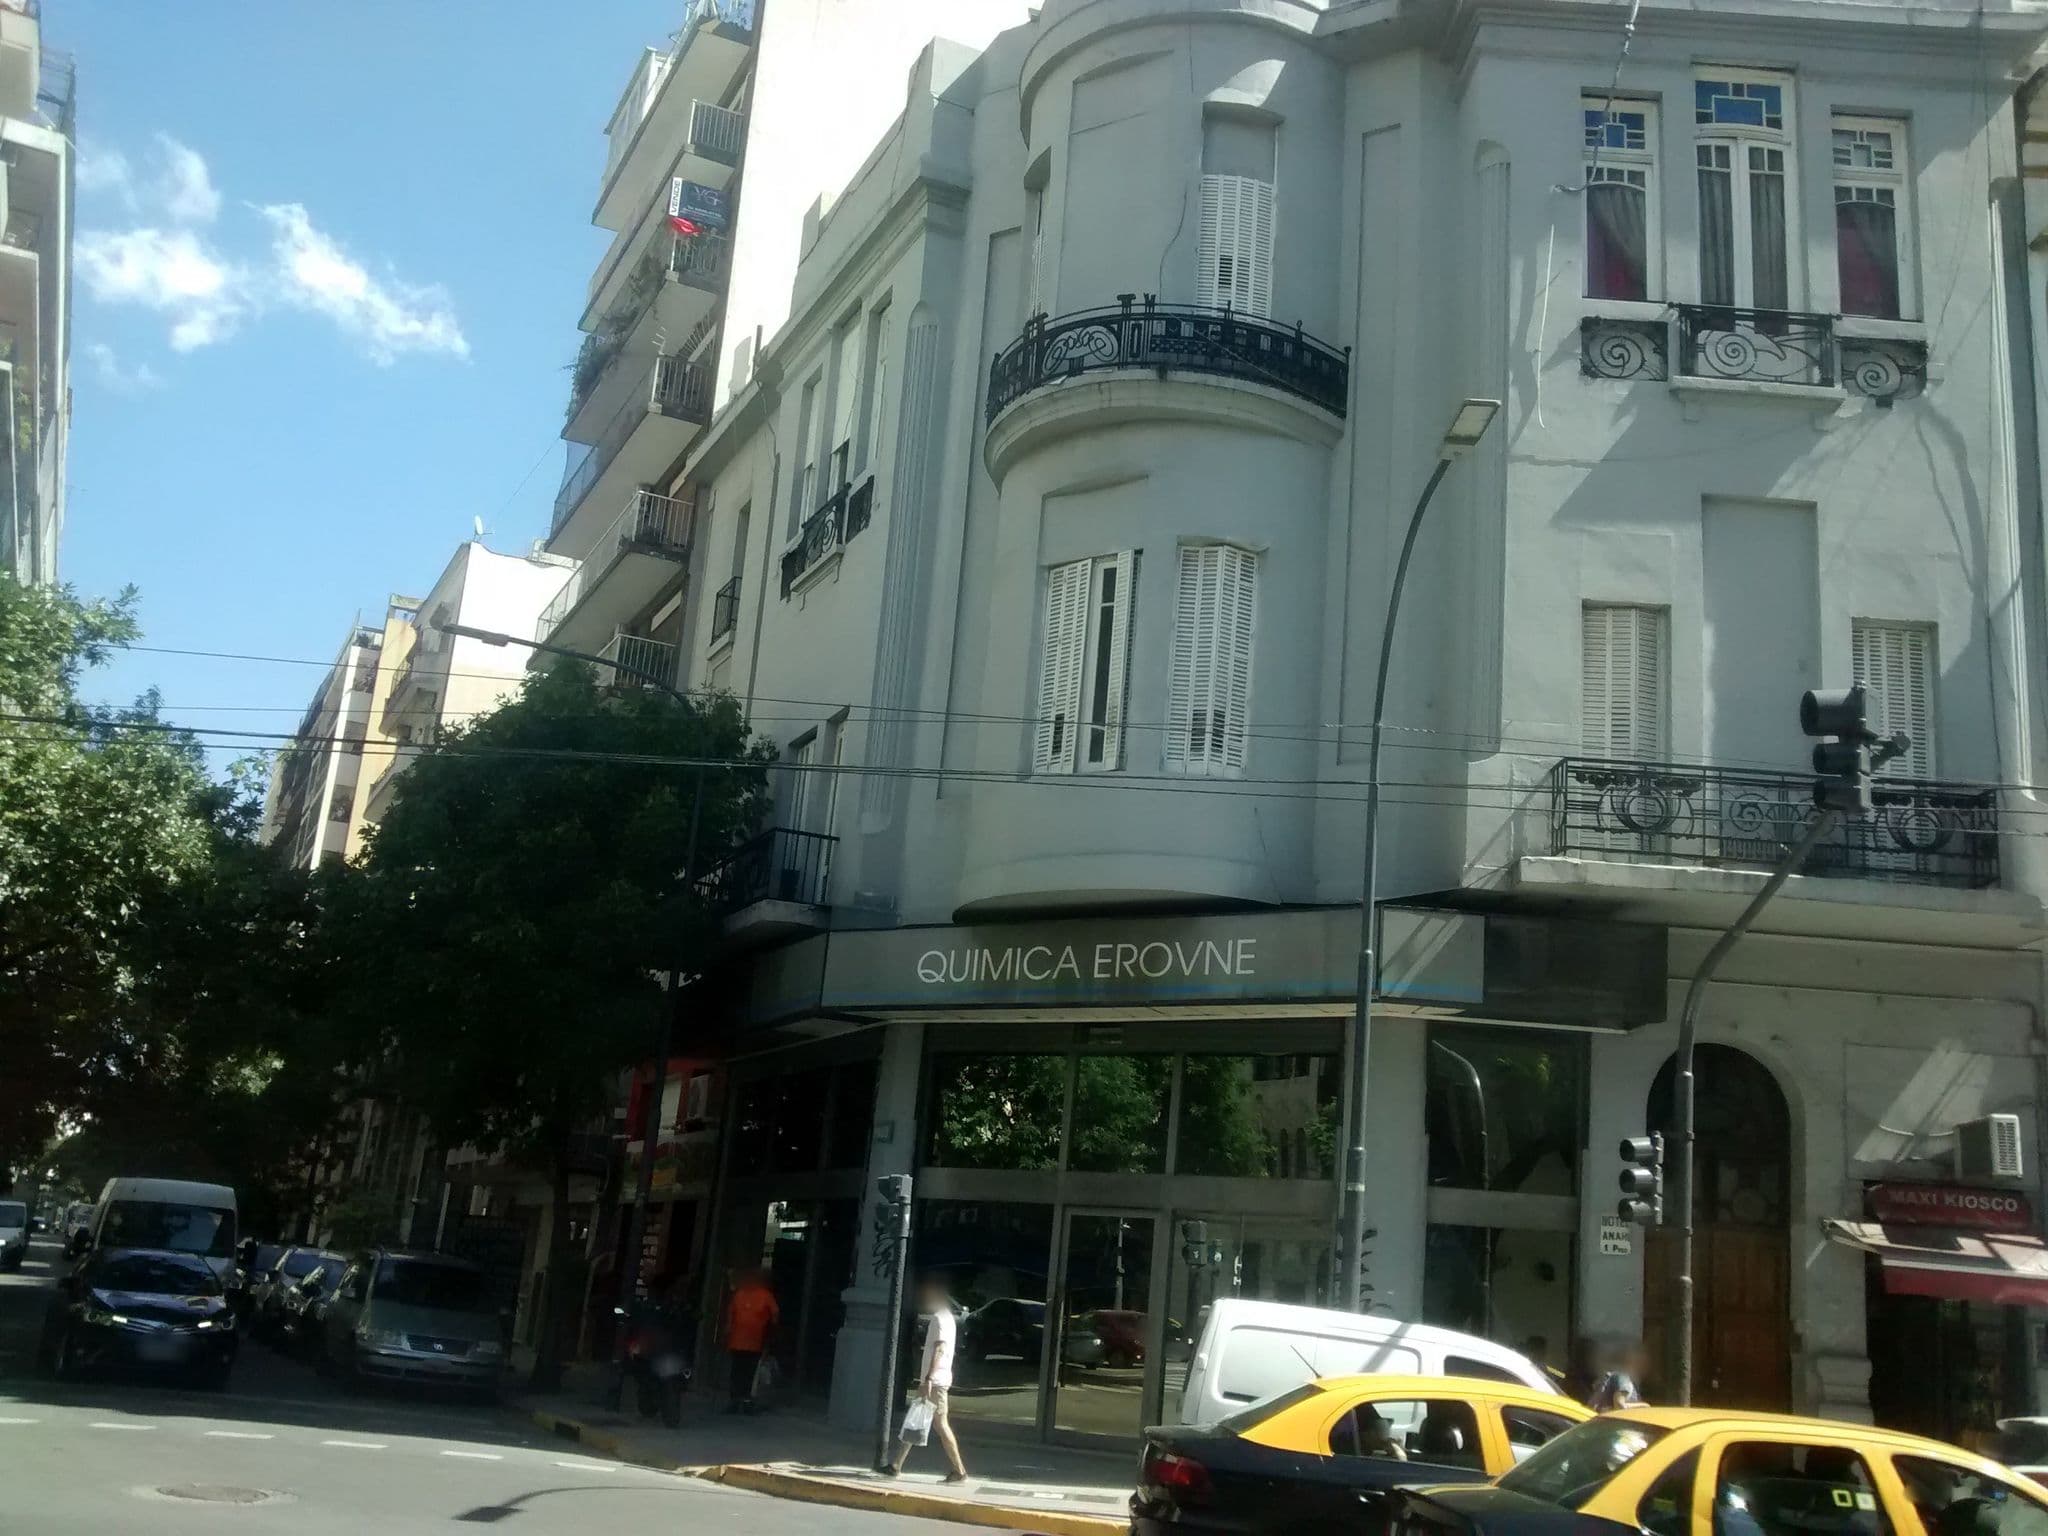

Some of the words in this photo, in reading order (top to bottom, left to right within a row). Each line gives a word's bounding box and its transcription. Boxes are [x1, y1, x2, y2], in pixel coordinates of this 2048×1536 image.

[917, 945, 1081, 983] QUIMICA
[1093, 939, 1257, 978] EROVNE
[1889, 1191, 1937, 1205] MAXI
[1943, 1193, 2018, 1212] KIOSCO
